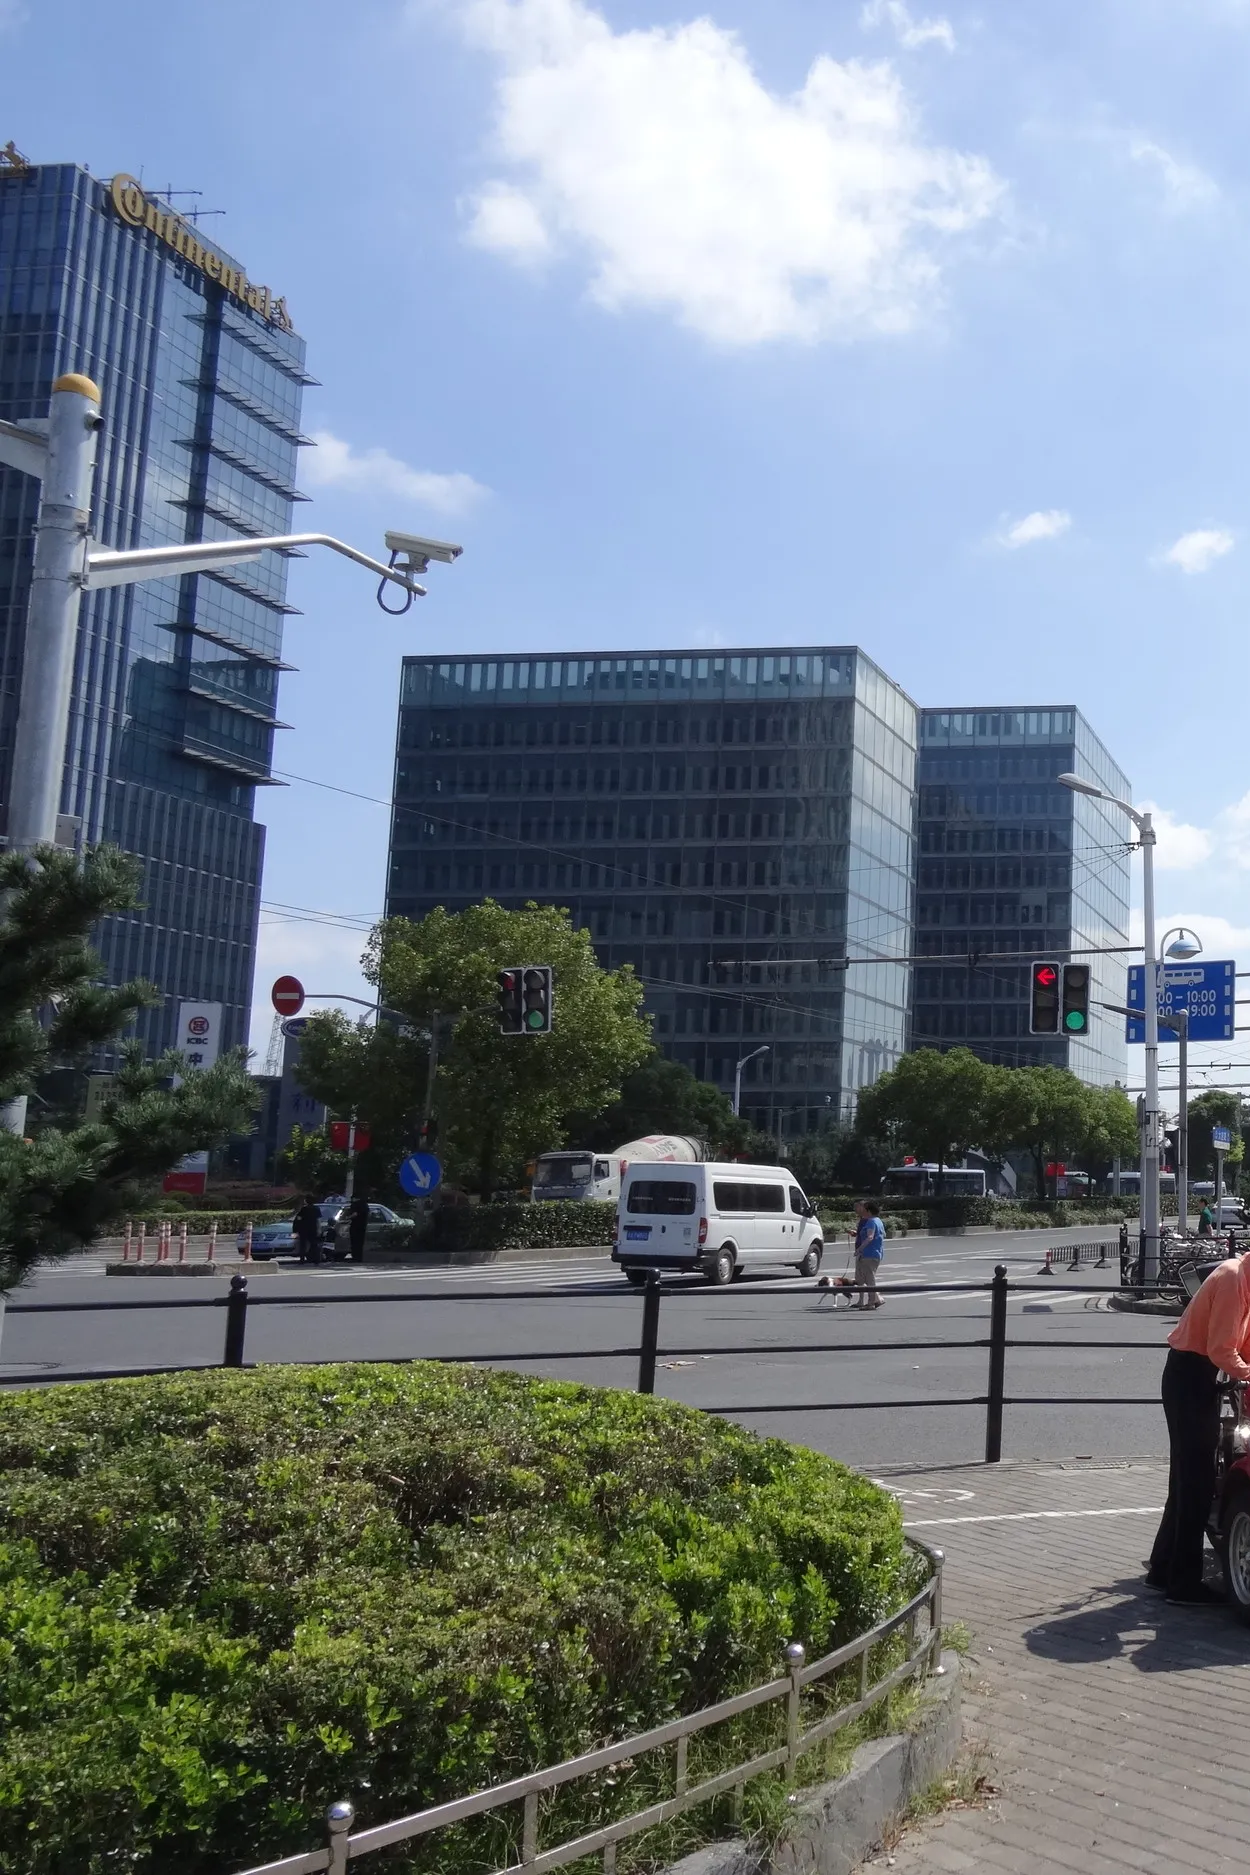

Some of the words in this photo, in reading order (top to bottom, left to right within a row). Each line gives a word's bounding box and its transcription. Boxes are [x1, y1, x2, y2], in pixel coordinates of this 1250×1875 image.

[111, 173, 272, 321] Continental
[1187, 989, 1216, 1003] 10:00
[1187, 1004, 1216, 1017] 19:00
[186, 1037, 209, 1045] ICBC
[652, 1140, 678, 1156] SANY
